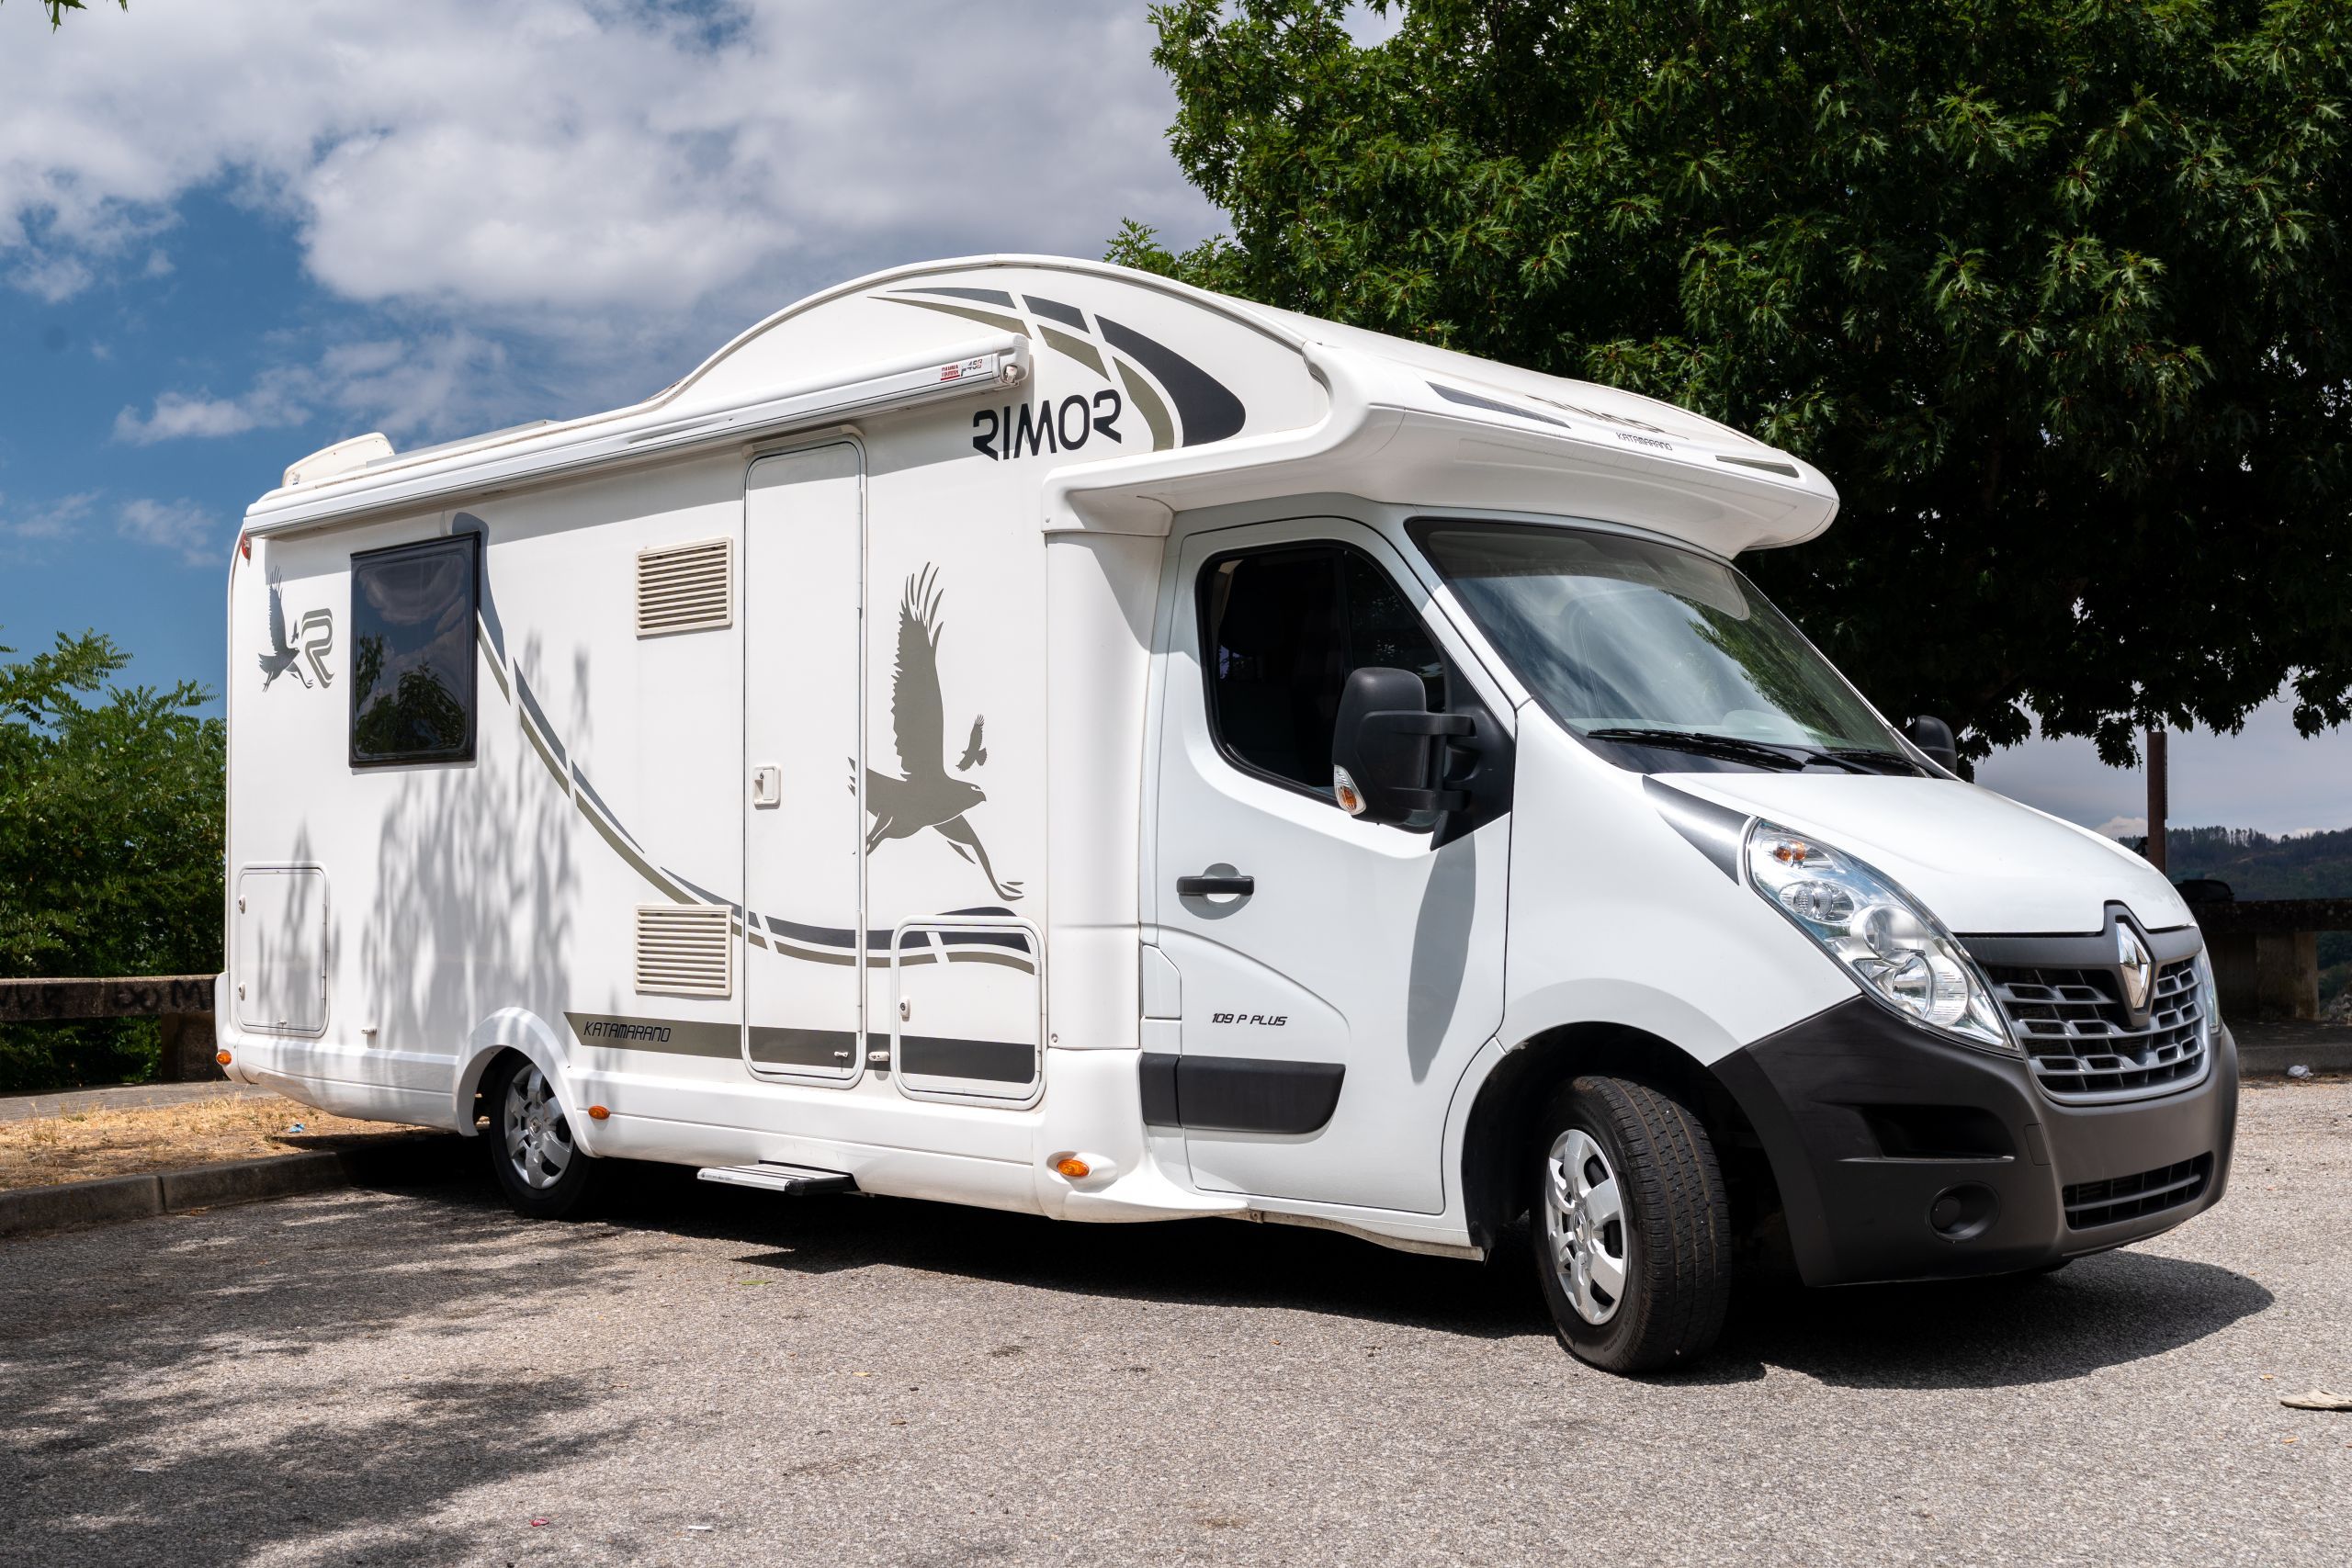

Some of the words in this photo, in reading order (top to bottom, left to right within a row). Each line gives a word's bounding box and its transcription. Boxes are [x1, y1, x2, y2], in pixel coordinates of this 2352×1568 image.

[972, 389, 1123, 461] RIMOR
[1615, 432, 1673, 451] KATAMARANO
[1212, 1012, 1234, 1024] 109
[1236, 1014, 1248, 1024] P
[1250, 1014, 1288, 1026] PLUS
[583, 1021, 672, 1043] KATAMARANO
